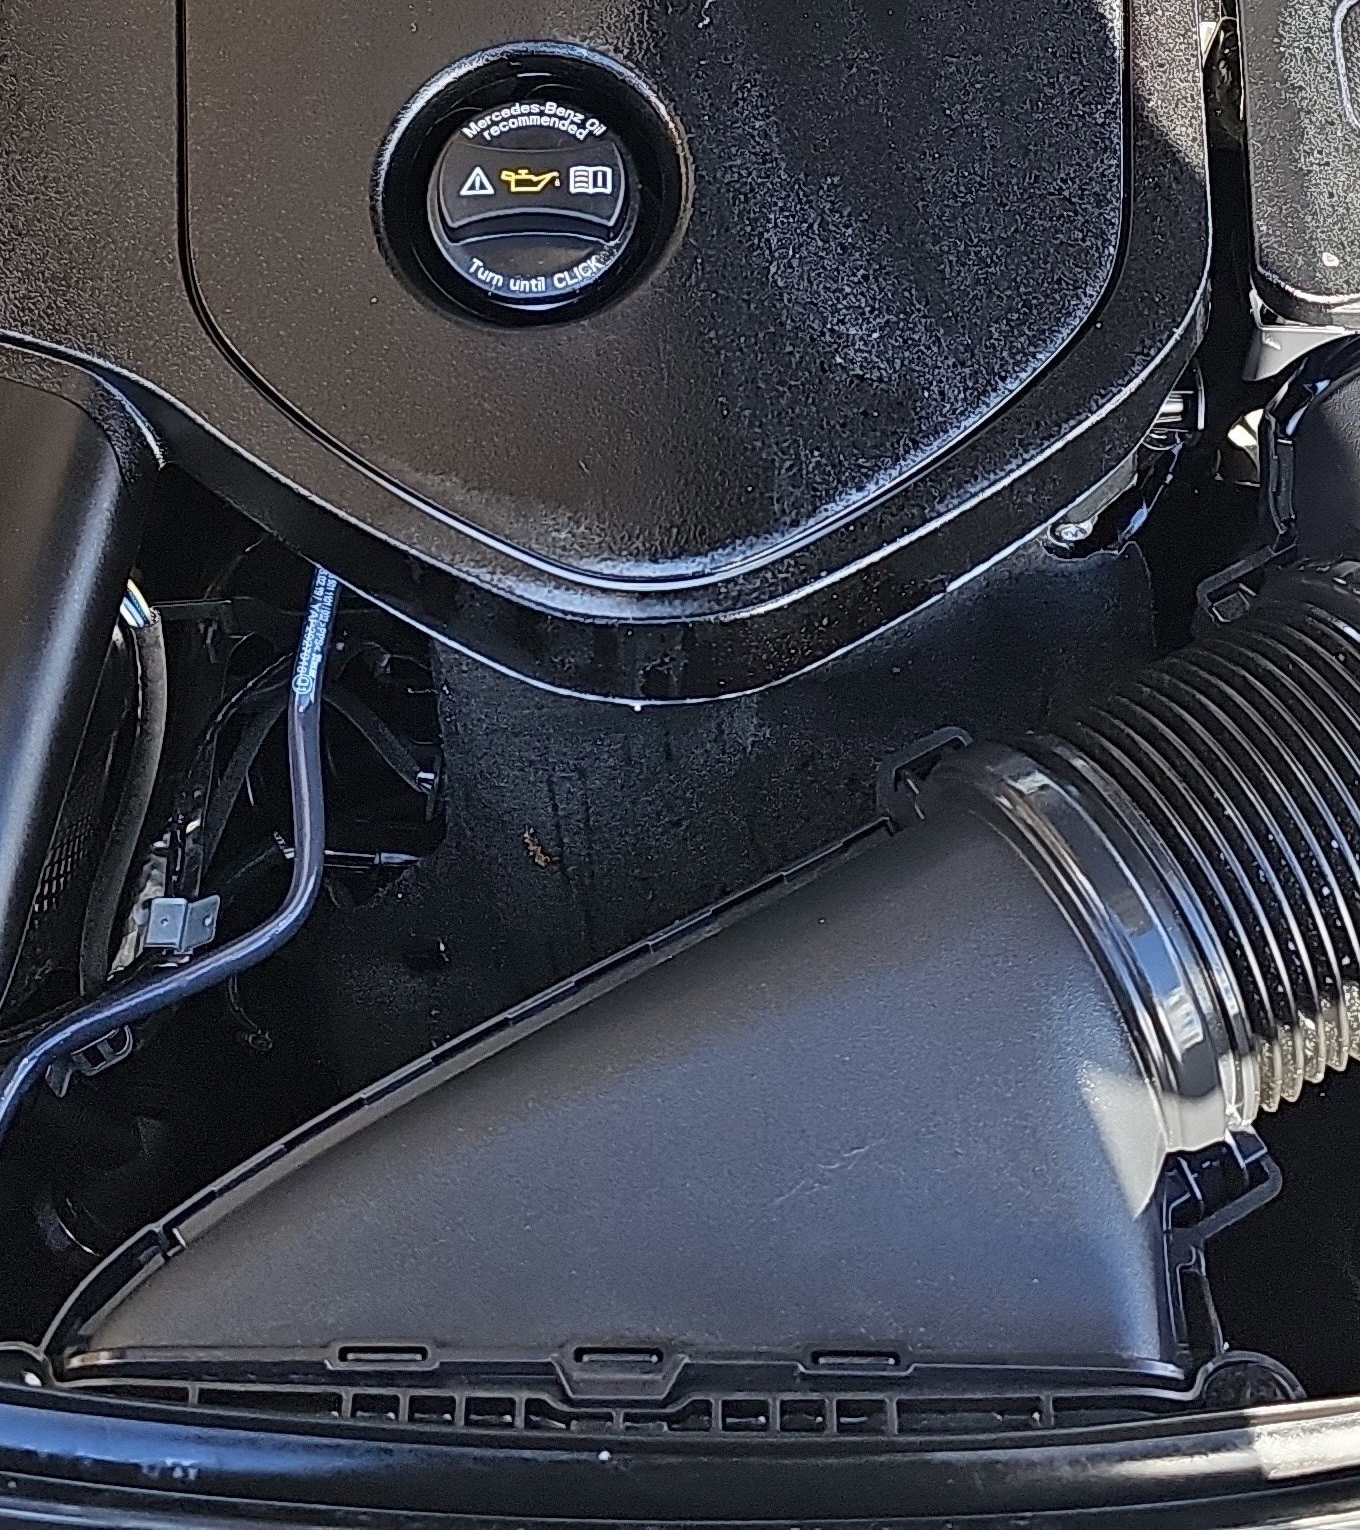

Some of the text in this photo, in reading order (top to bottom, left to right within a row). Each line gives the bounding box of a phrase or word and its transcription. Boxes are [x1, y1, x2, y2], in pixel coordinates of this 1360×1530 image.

[460, 101, 608, 140] Mercedes-Benz Oil
[482, 115, 590, 141] recommended
[468, 254, 606, 293] Turn until CLICK
